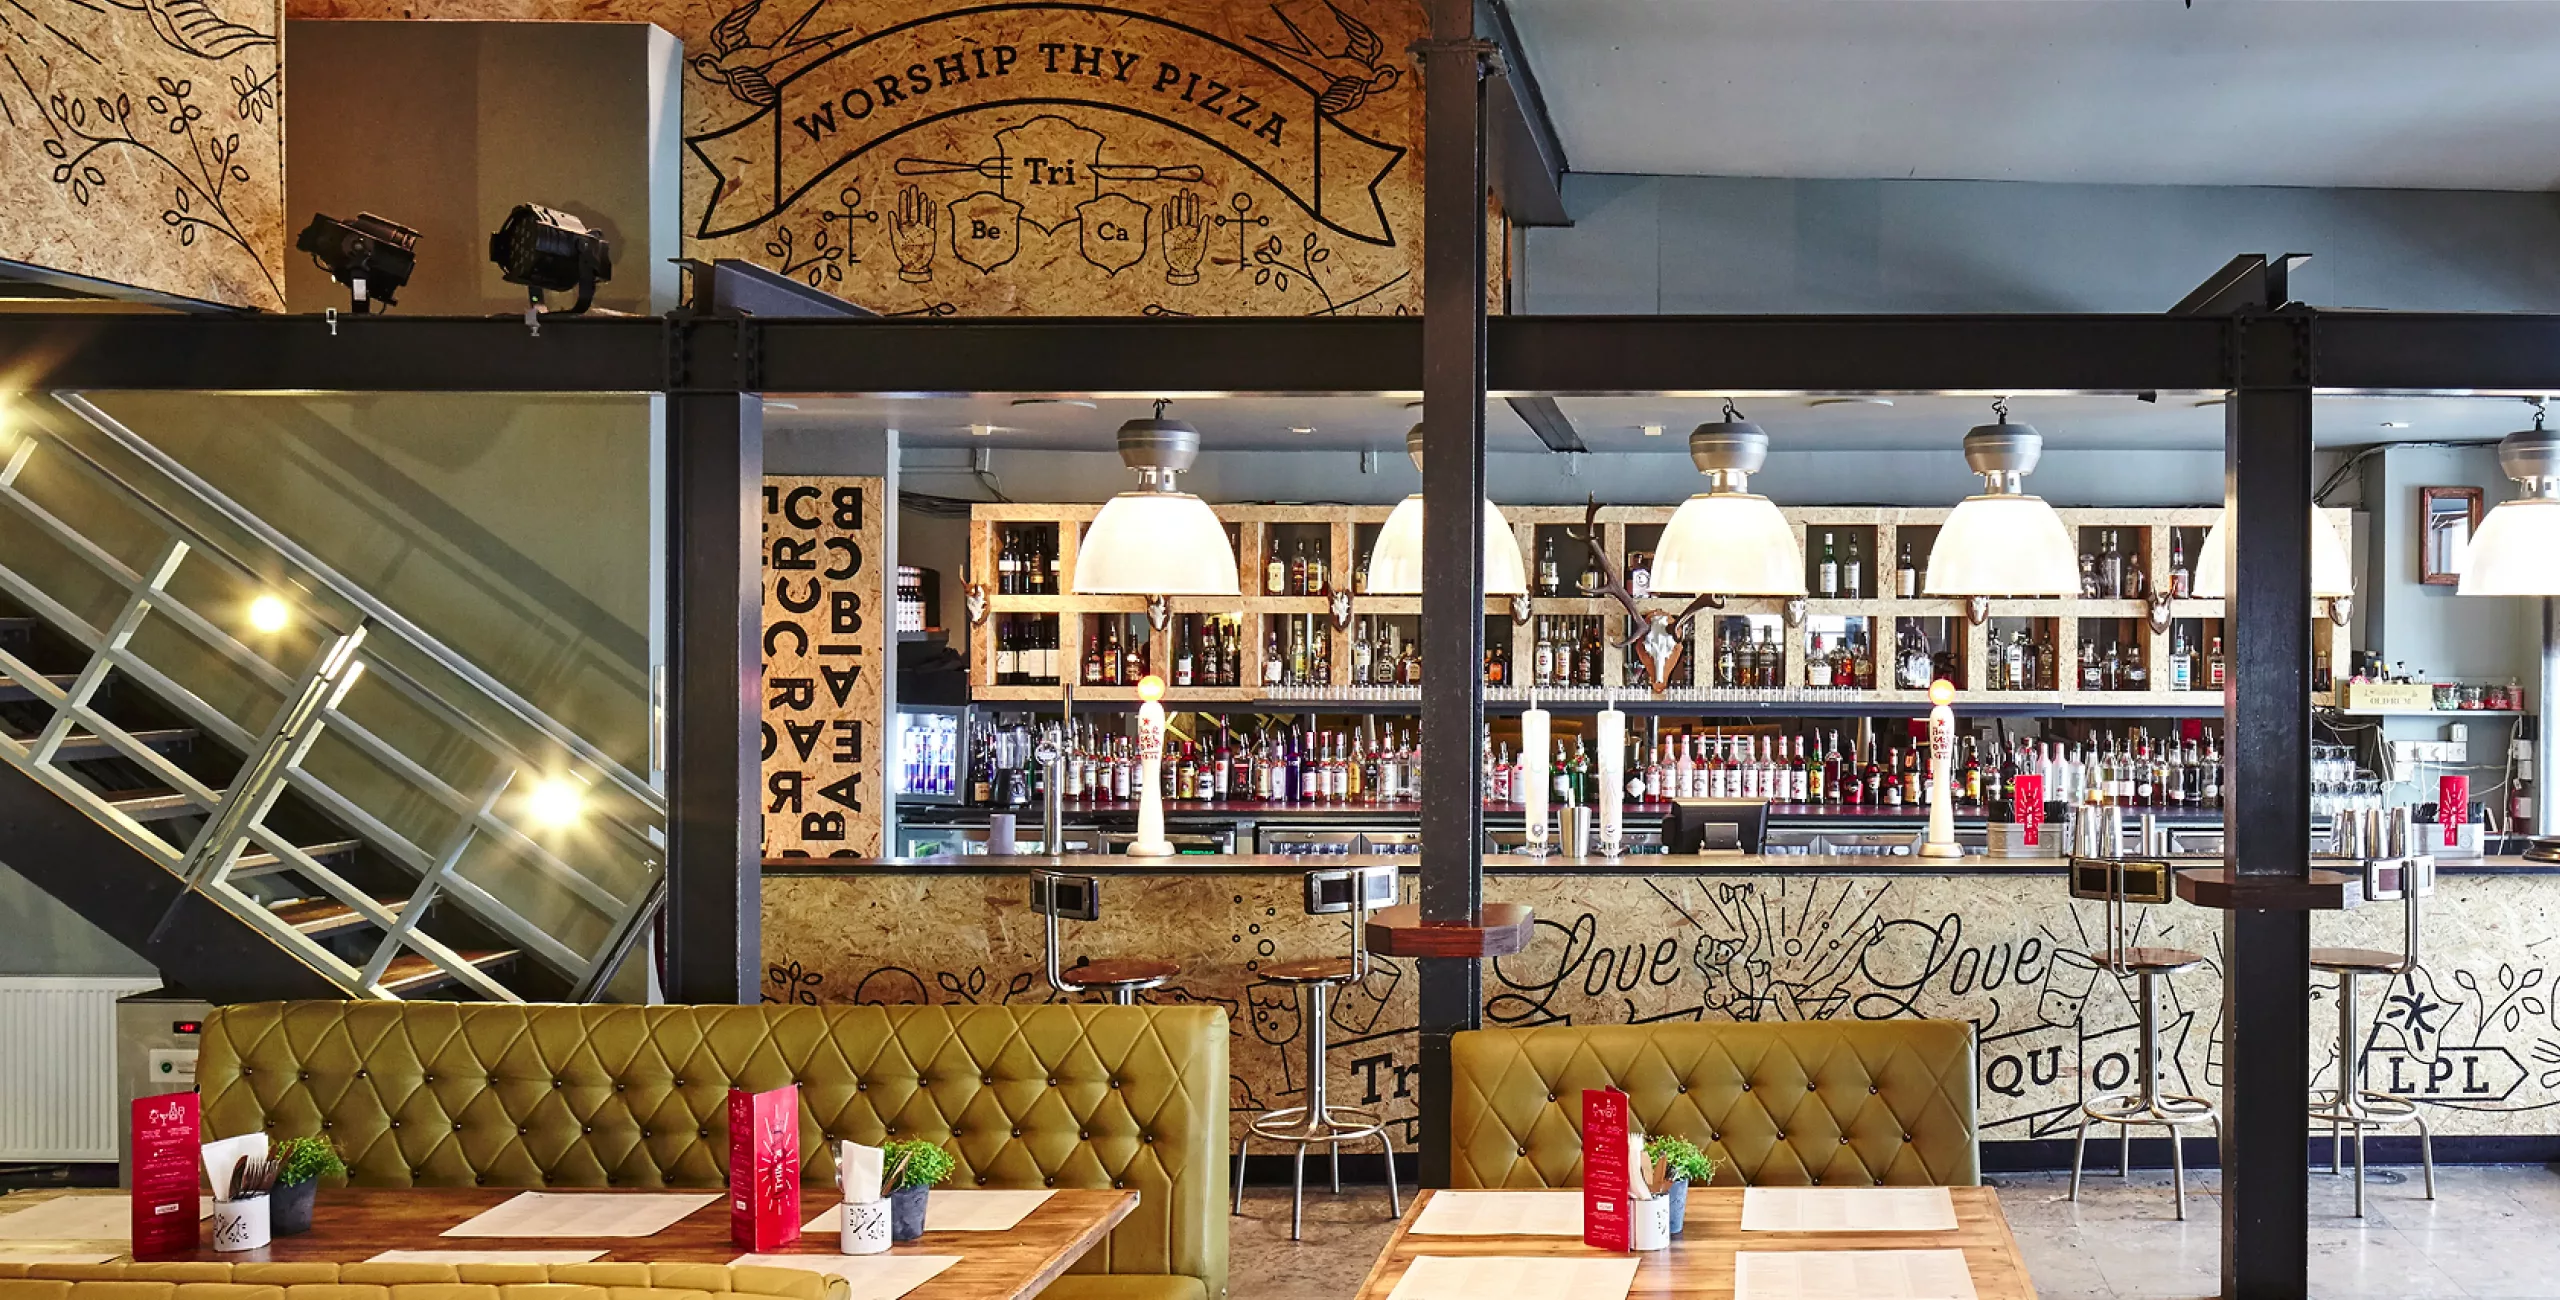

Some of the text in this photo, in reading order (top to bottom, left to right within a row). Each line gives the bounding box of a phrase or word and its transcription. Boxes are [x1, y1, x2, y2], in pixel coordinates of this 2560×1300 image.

[794, 42, 1288, 148] WORSHIP THY PIZZA
[1023, 158, 1075, 187] Tri
[972, 221, 1001, 241] Be
[1097, 222, 1129, 242] Ca
[1486, 912, 1681, 1023] Love
[1853, 912, 2046, 1021] Love
[2388, 1055, 2490, 1094] LPL
